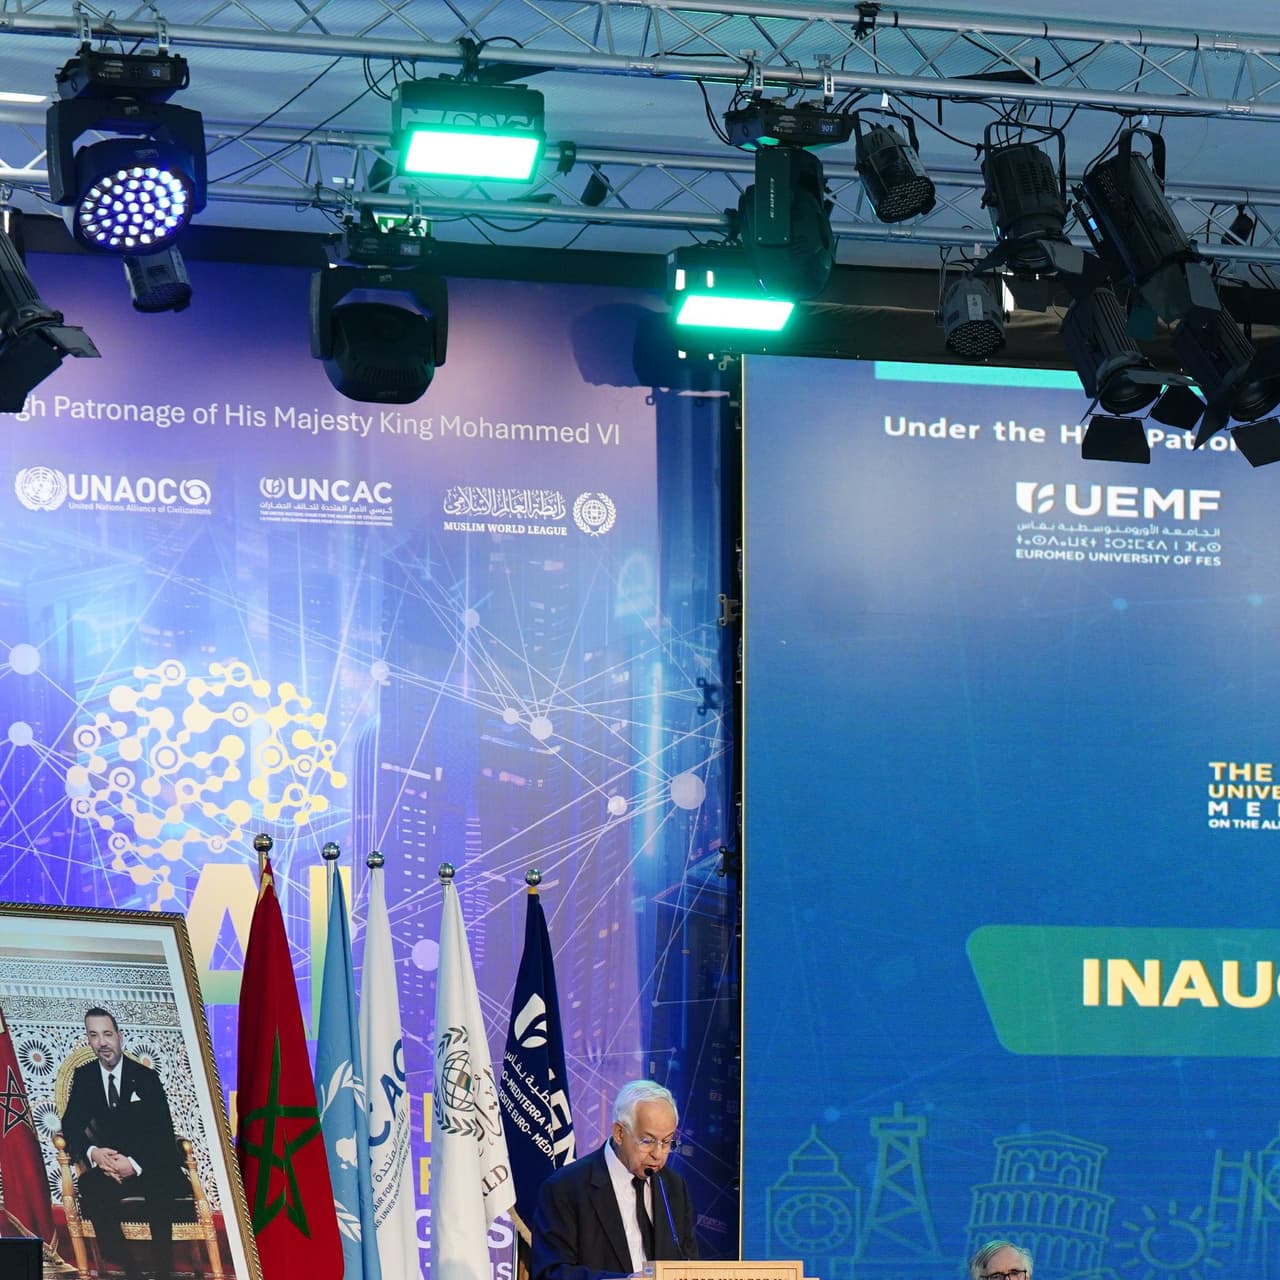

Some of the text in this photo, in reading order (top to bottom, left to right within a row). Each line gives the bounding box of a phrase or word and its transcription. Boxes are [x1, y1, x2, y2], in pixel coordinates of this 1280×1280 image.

[54, 395, 186, 428] Patronage
[192, 403, 218, 425] of
[225, 404, 267, 427] His
[273, 406, 373, 437] Majesty
[379, 410, 434, 441] King
[440, 413, 590, 445] Mohammed
[596, 422, 621, 446] VI
[884, 416, 981, 440] Under
[994, 421, 1046, 444] the
[68, 473, 178, 505] UNAOC
[287, 477, 393, 505] UNCAC
[1065, 484, 1221, 521] UEMF
[444, 521, 568, 537] MUSLIM WORLD LEAGUE
[1016, 549, 1222, 567] EUROMED UNIVERSITY OF FES
[1208, 762, 1273, 782] THE
[1208, 818, 1229, 829] ON
[1232, 819, 1258, 830] THE
